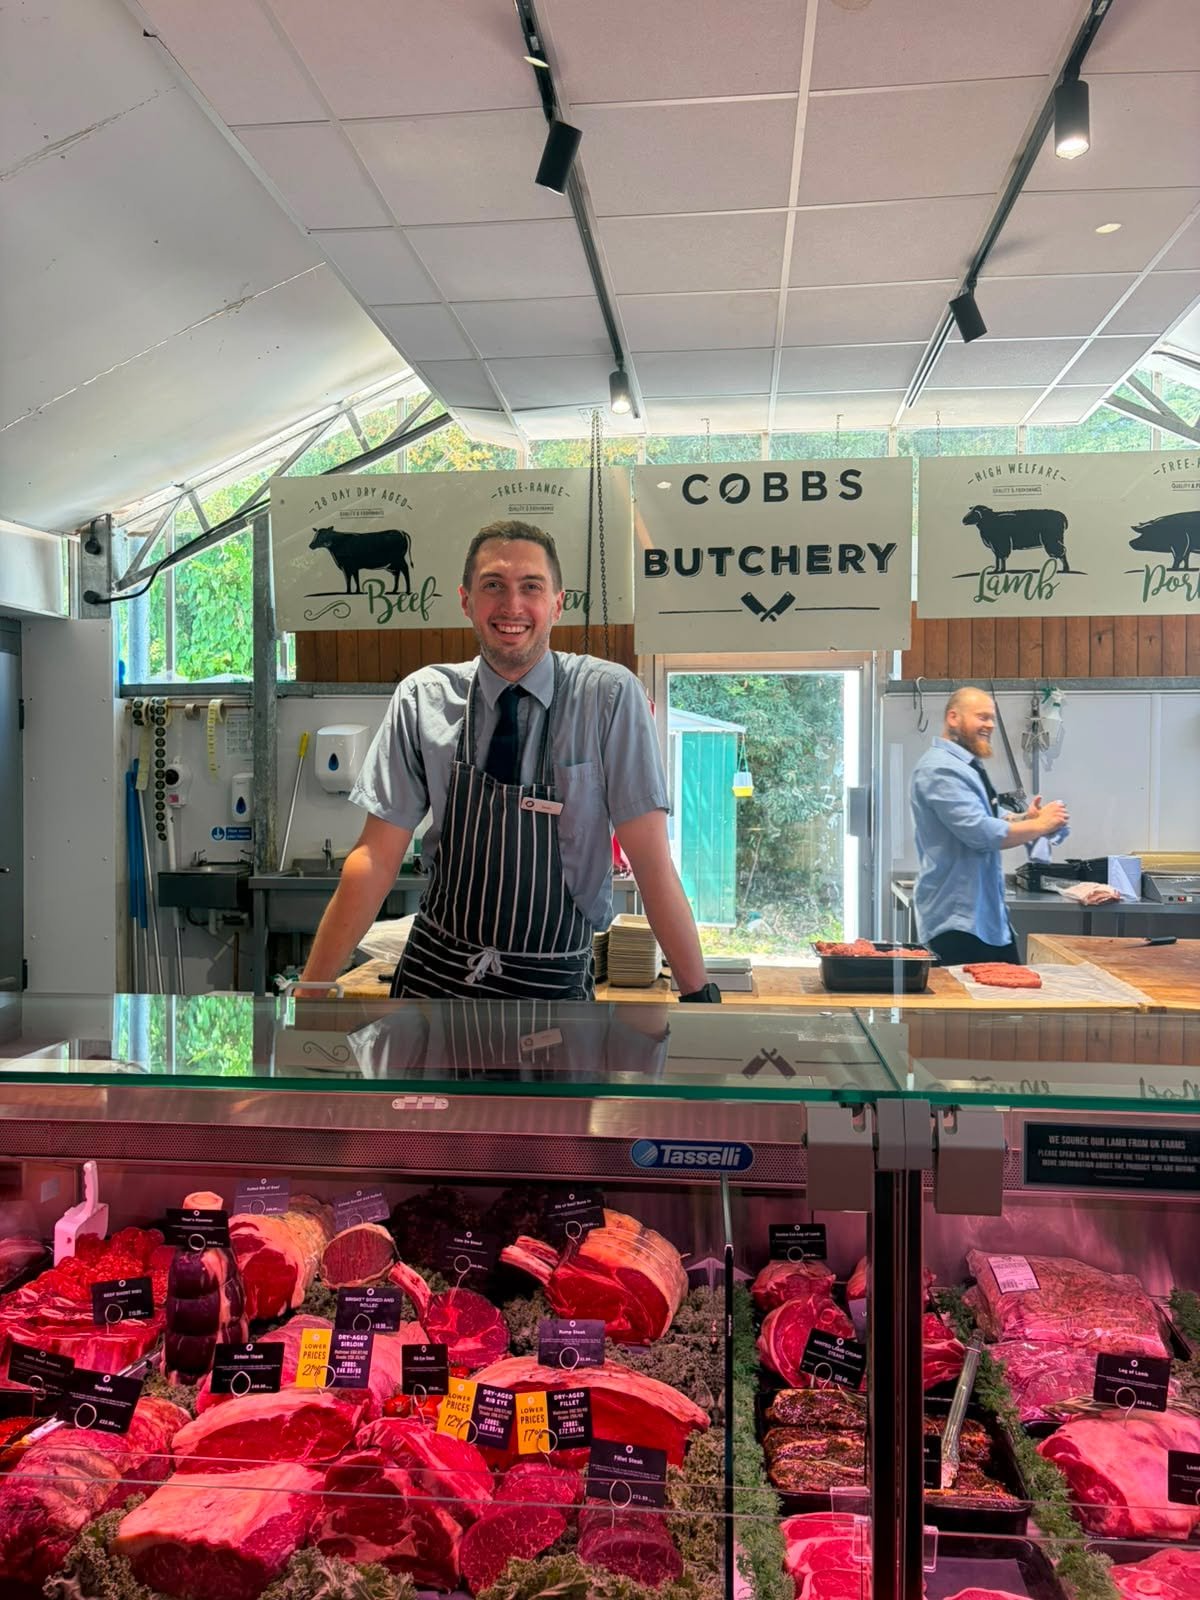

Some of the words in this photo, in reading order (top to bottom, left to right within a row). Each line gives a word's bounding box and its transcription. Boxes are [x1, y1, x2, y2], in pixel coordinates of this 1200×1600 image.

[975, 465, 1002, 482] HIGH
[1008, 462, 1060, 480] WELFARE
[498, 482, 564, 497] FREE-RANGE
[682, 468, 863, 505] COBBS
[314, 496, 328, 510] 28
[332, 488, 350, 501] DAY
[357, 487, 376, 496] DRY
[382, 489, 408, 507] AGED
[644, 542, 898, 578] BUTCHERY
[973, 558, 1060, 604] Lamb
[362, 576, 436, 624] Beef
[1048, 1136, 1060, 1144] WE
[1062, 1136, 1088, 1146] SOURCE
[1090, 1137, 1105, 1146] OUR
[1107, 1138, 1126, 1147] LAMB
[1128, 1138, 1148, 1148] FROM
[1161, 1140, 1186, 1150] FARMS
[660, 1144, 742, 1166] Tasselli
[303, 1351, 326, 1360] PRICES
[448, 1393, 470, 1401] LOWER
[483, 1389, 513, 1400] DRY-AGED
[554, 1392, 584, 1400] DRY-AGED
[446, 1400, 470, 1412] PRICES
[520, 1415, 544, 1424] PRICES
